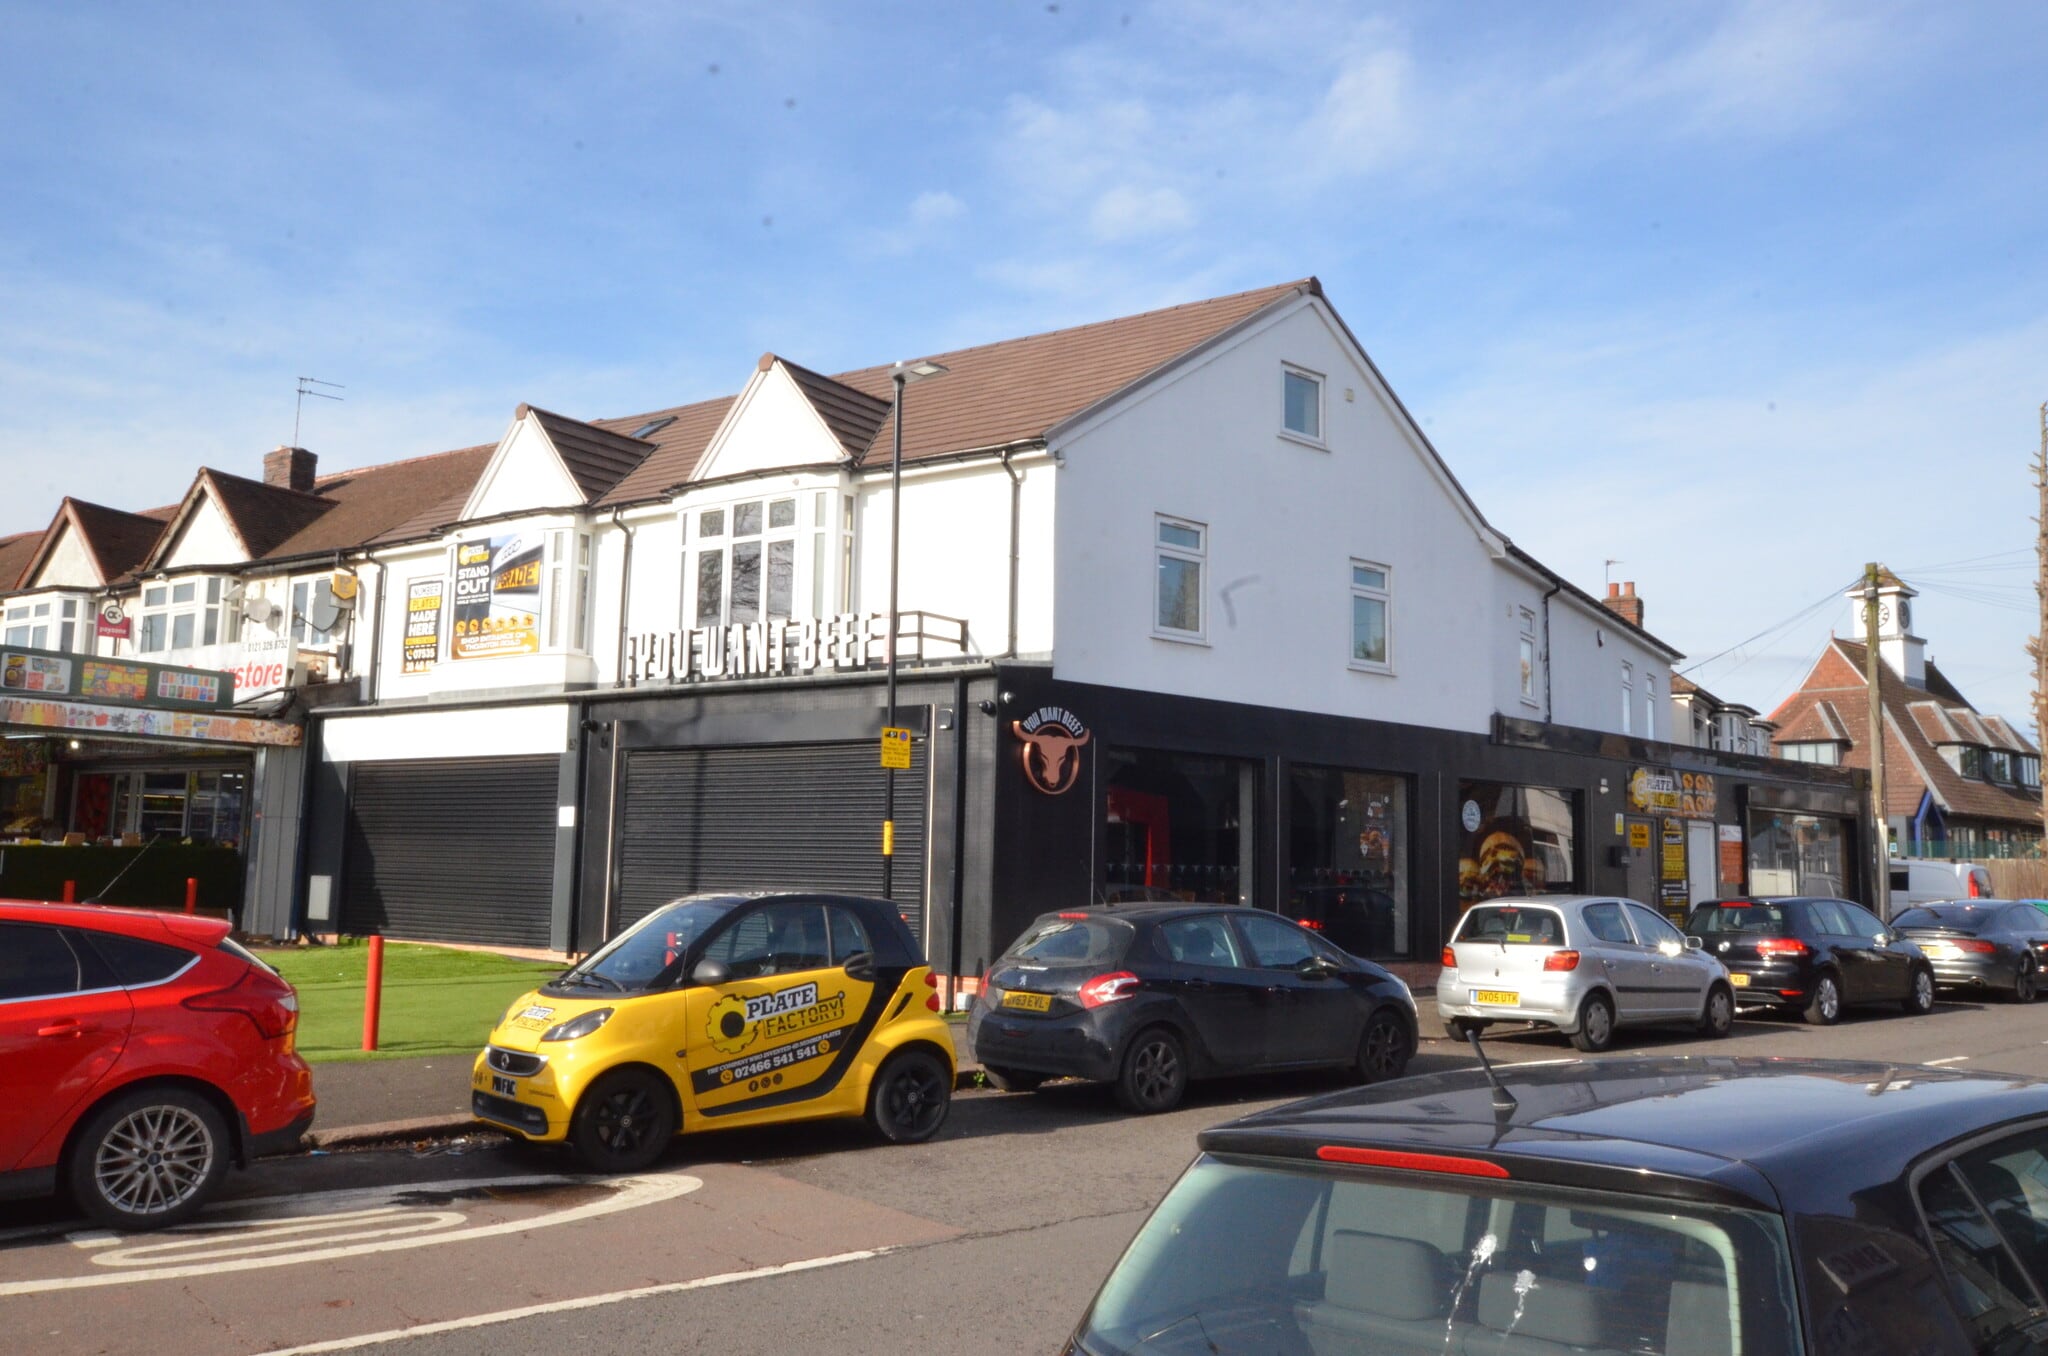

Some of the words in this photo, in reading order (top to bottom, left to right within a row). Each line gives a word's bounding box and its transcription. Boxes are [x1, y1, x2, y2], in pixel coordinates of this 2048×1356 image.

[458, 565, 490, 580] STAND
[457, 577, 490, 595] OUT
[412, 598, 438, 609] PLATES
[410, 610, 437, 623] MADE
[408, 622, 436, 636] HERE
[632, 629, 692, 681] YOU
[701, 618, 788, 677] WANT
[1022, 711, 1041, 732] YOU
[1039, 706, 1063, 722] WANT
[1061, 710, 1084, 736] BEEF?
[747, 986, 813, 1020] PLATE
[734, 1059, 771, 1078] 07466
[773, 1052, 794, 1067] 541
[797, 1045, 818, 1060] 541
